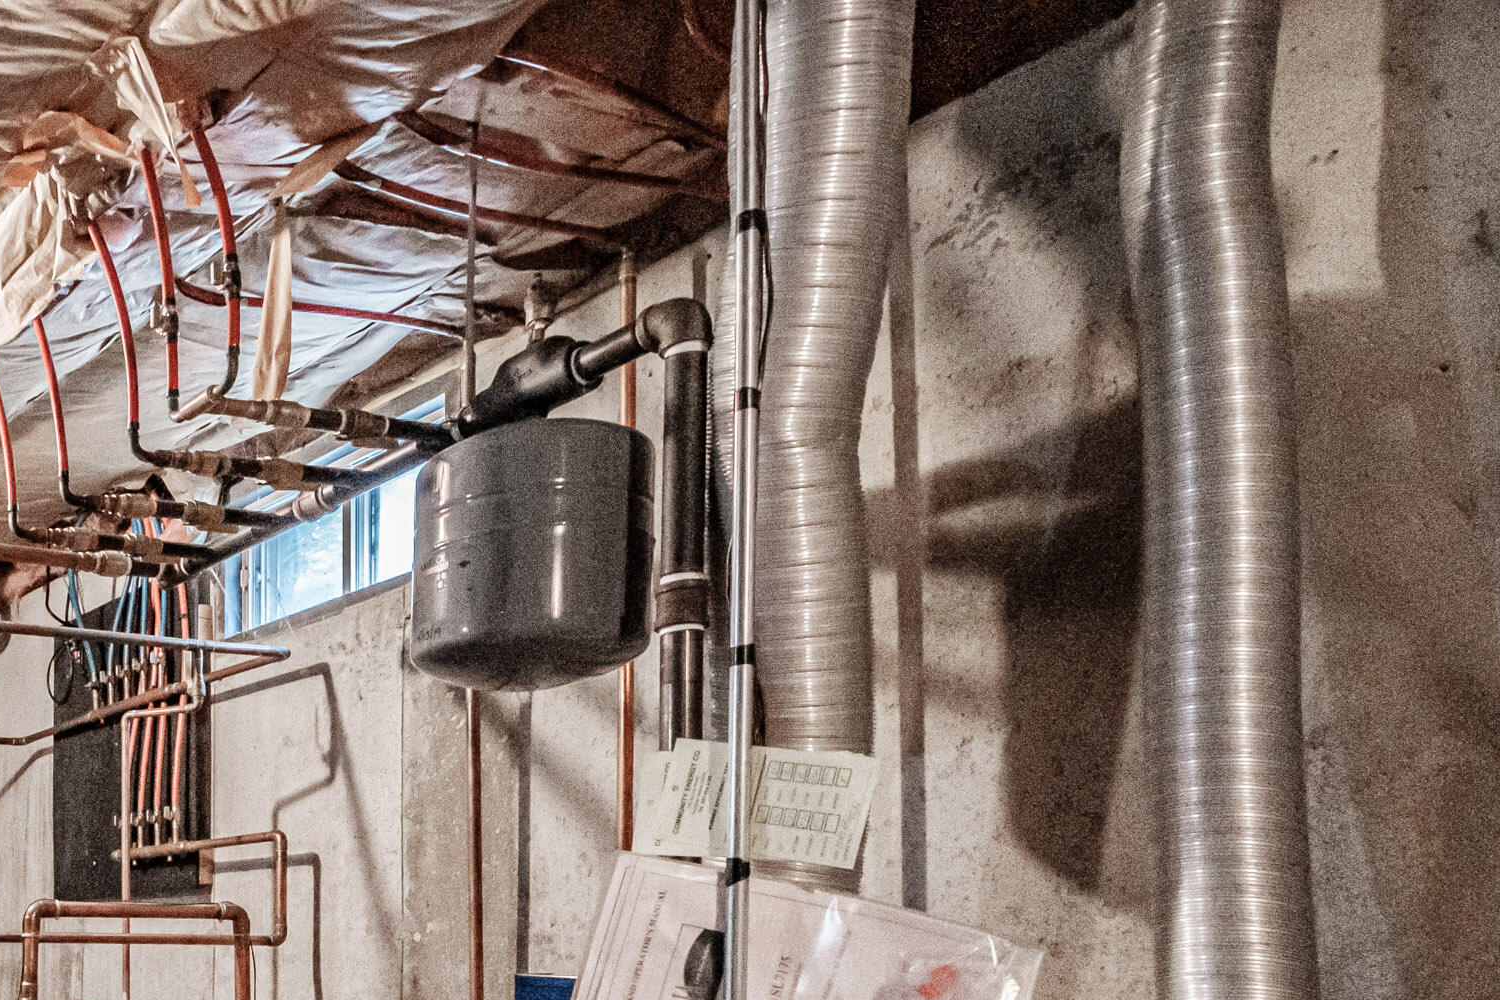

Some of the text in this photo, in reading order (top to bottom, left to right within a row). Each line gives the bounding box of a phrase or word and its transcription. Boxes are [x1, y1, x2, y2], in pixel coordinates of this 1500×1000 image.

[672, 792, 688, 835] COMMUNITY
[684, 762, 697, 792] ENERGY
[627, 984, 637, 1000] AND
